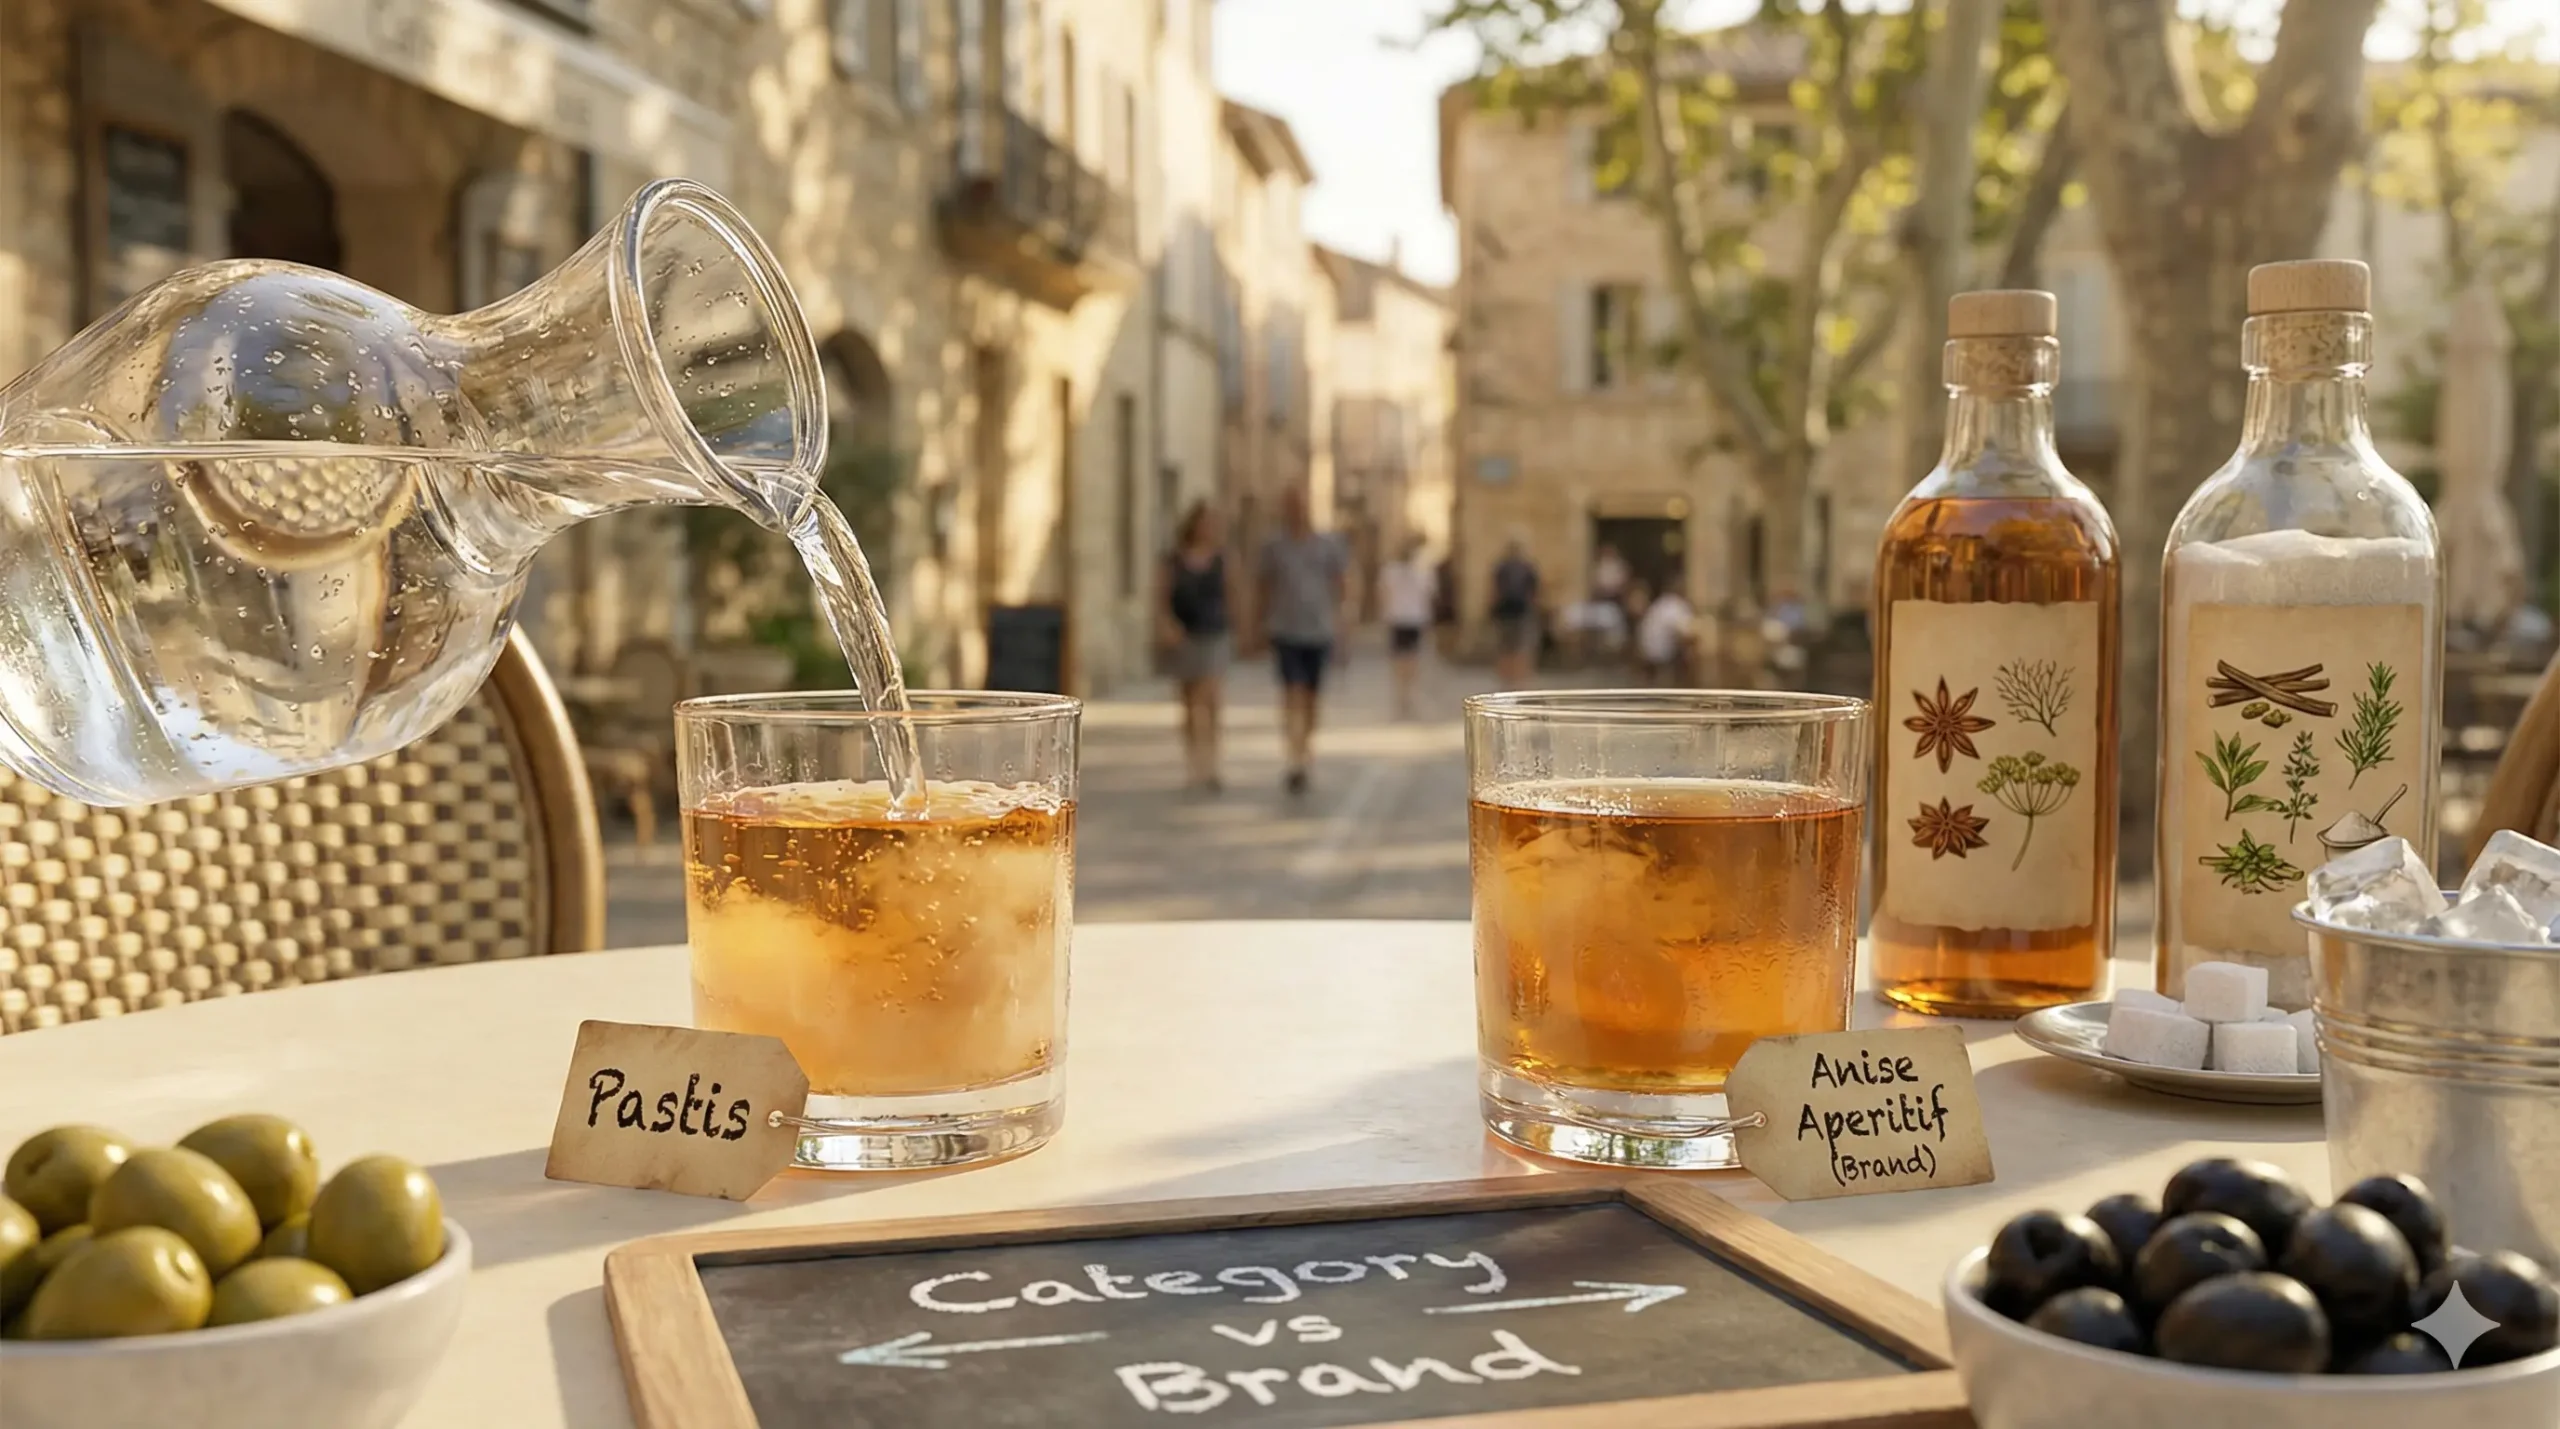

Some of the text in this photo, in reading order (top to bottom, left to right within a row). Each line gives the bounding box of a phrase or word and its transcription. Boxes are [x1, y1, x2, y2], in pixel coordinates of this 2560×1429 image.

[1811, 1050, 1919, 1089] Anise
[587, 1068, 751, 1141] Pastis
[1797, 1084, 1949, 1154] Aperitif
[1831, 1144, 1937, 1187] (Brand)
[909, 1251, 1507, 1314] Category
[1210, 1314, 1344, 1347] vs
[1113, 1328, 1583, 1414] Brand
